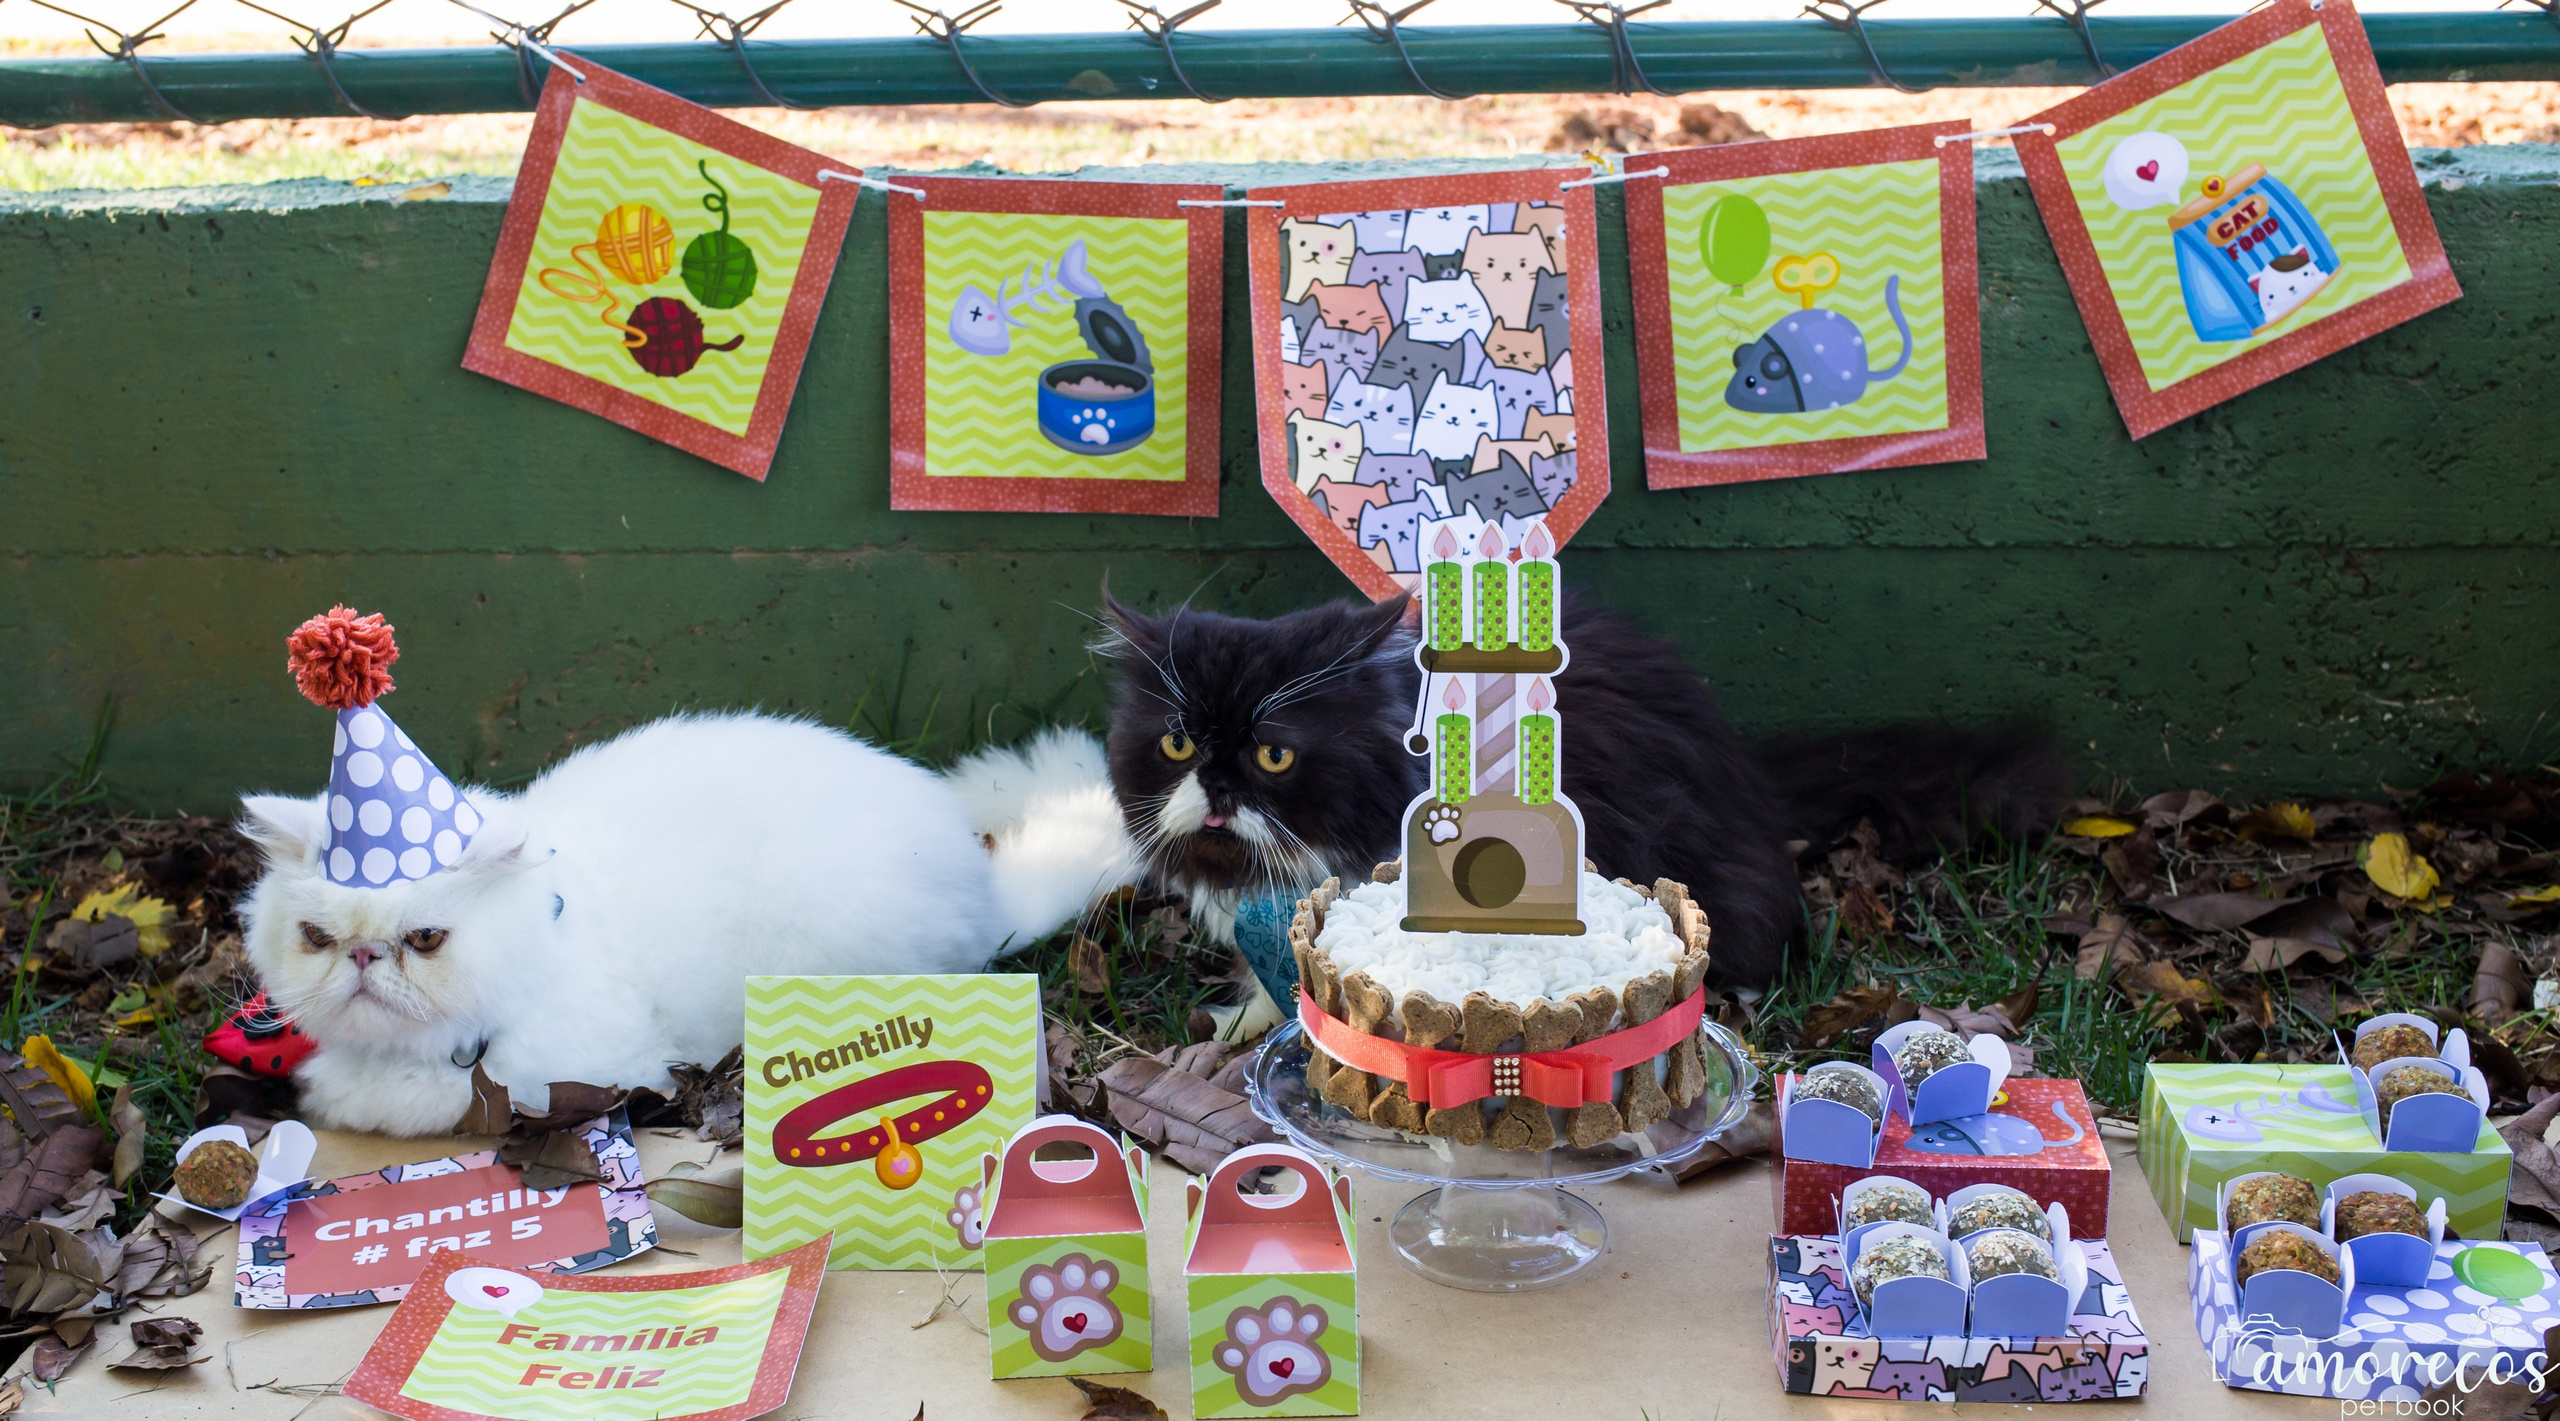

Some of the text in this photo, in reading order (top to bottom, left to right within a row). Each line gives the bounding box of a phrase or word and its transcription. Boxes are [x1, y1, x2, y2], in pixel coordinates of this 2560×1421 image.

[2217, 200, 2258, 239] CAT
[2226, 217, 2279, 262] FOOD
[763, 1015, 934, 1088] Chantilly
[315, 1184, 571, 1242] Chantilly
[405, 1230, 492, 1258] faz
[511, 1215, 543, 1241] 5
[518, 1363, 666, 1390] Feliz
